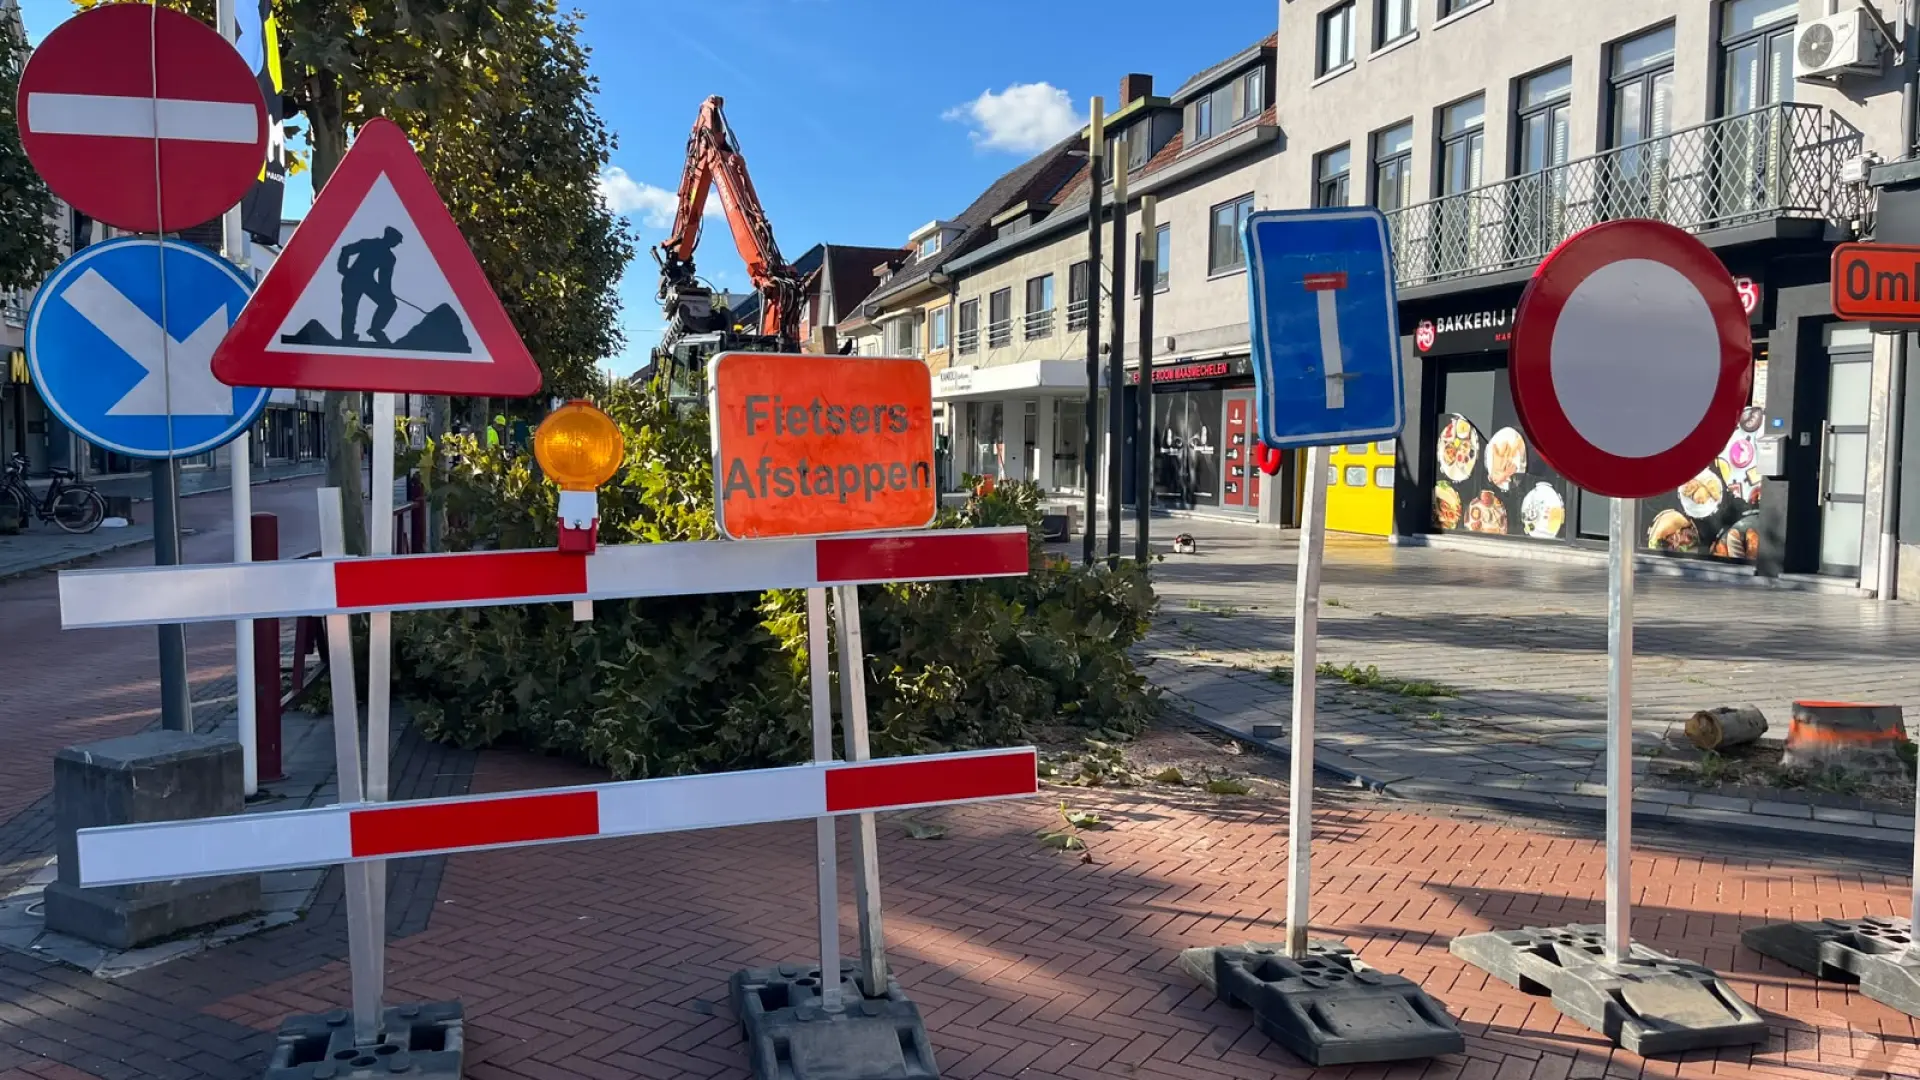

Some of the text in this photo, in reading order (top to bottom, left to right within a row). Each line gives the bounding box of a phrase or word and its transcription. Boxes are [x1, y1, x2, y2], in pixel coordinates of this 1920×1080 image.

[1437, 309, 1505, 333] BAKKERIJ
[1175, 362, 1228, 379] MAASMECHELEN
[744, 395, 909, 437] Fietsers
[723, 456, 932, 505] Afstappen
